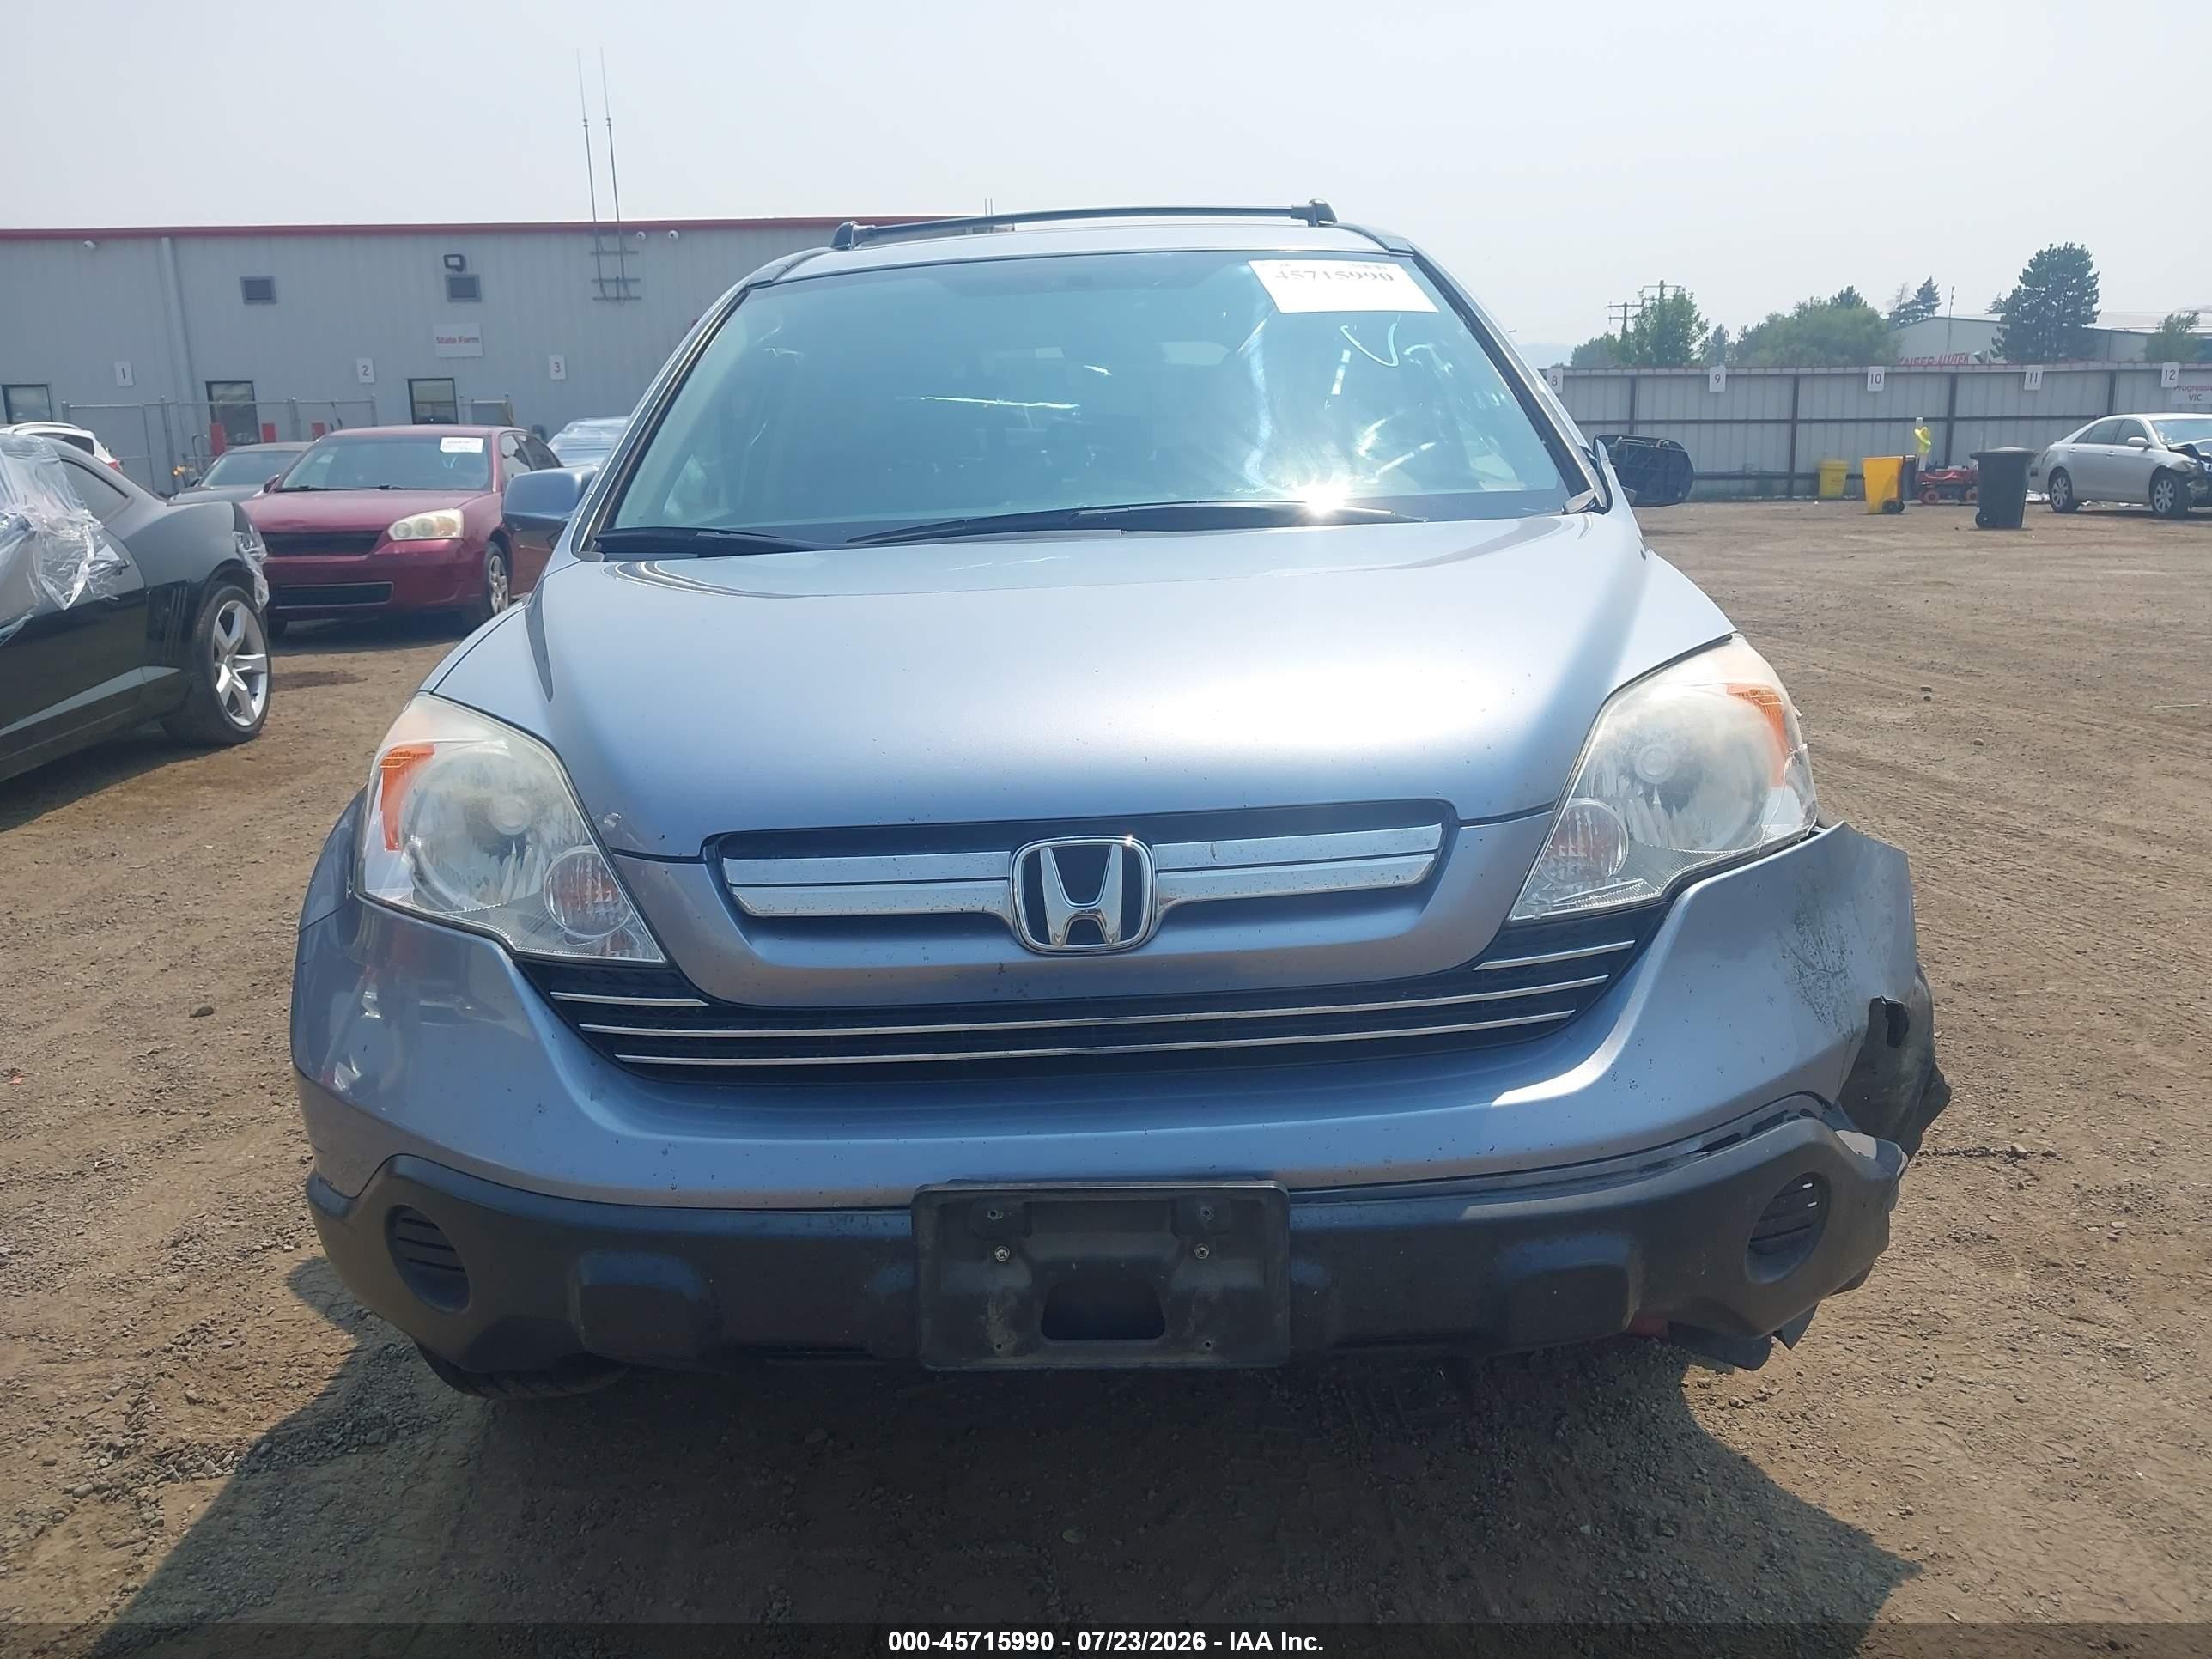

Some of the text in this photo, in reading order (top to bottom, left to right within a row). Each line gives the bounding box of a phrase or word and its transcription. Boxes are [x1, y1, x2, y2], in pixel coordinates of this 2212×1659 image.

[1276, 270, 1395, 282] 45715990
[362, 364, 369, 376] 2
[554, 361, 562, 373] 3
[1551, 375, 1558, 386] 8
[1714, 374, 1721, 385] 9
[1870, 372, 1881, 385] 10
[2029, 371, 2039, 384] 11
[2165, 369, 2176, 380] 12
[2188, 393, 2203, 402] VIC
